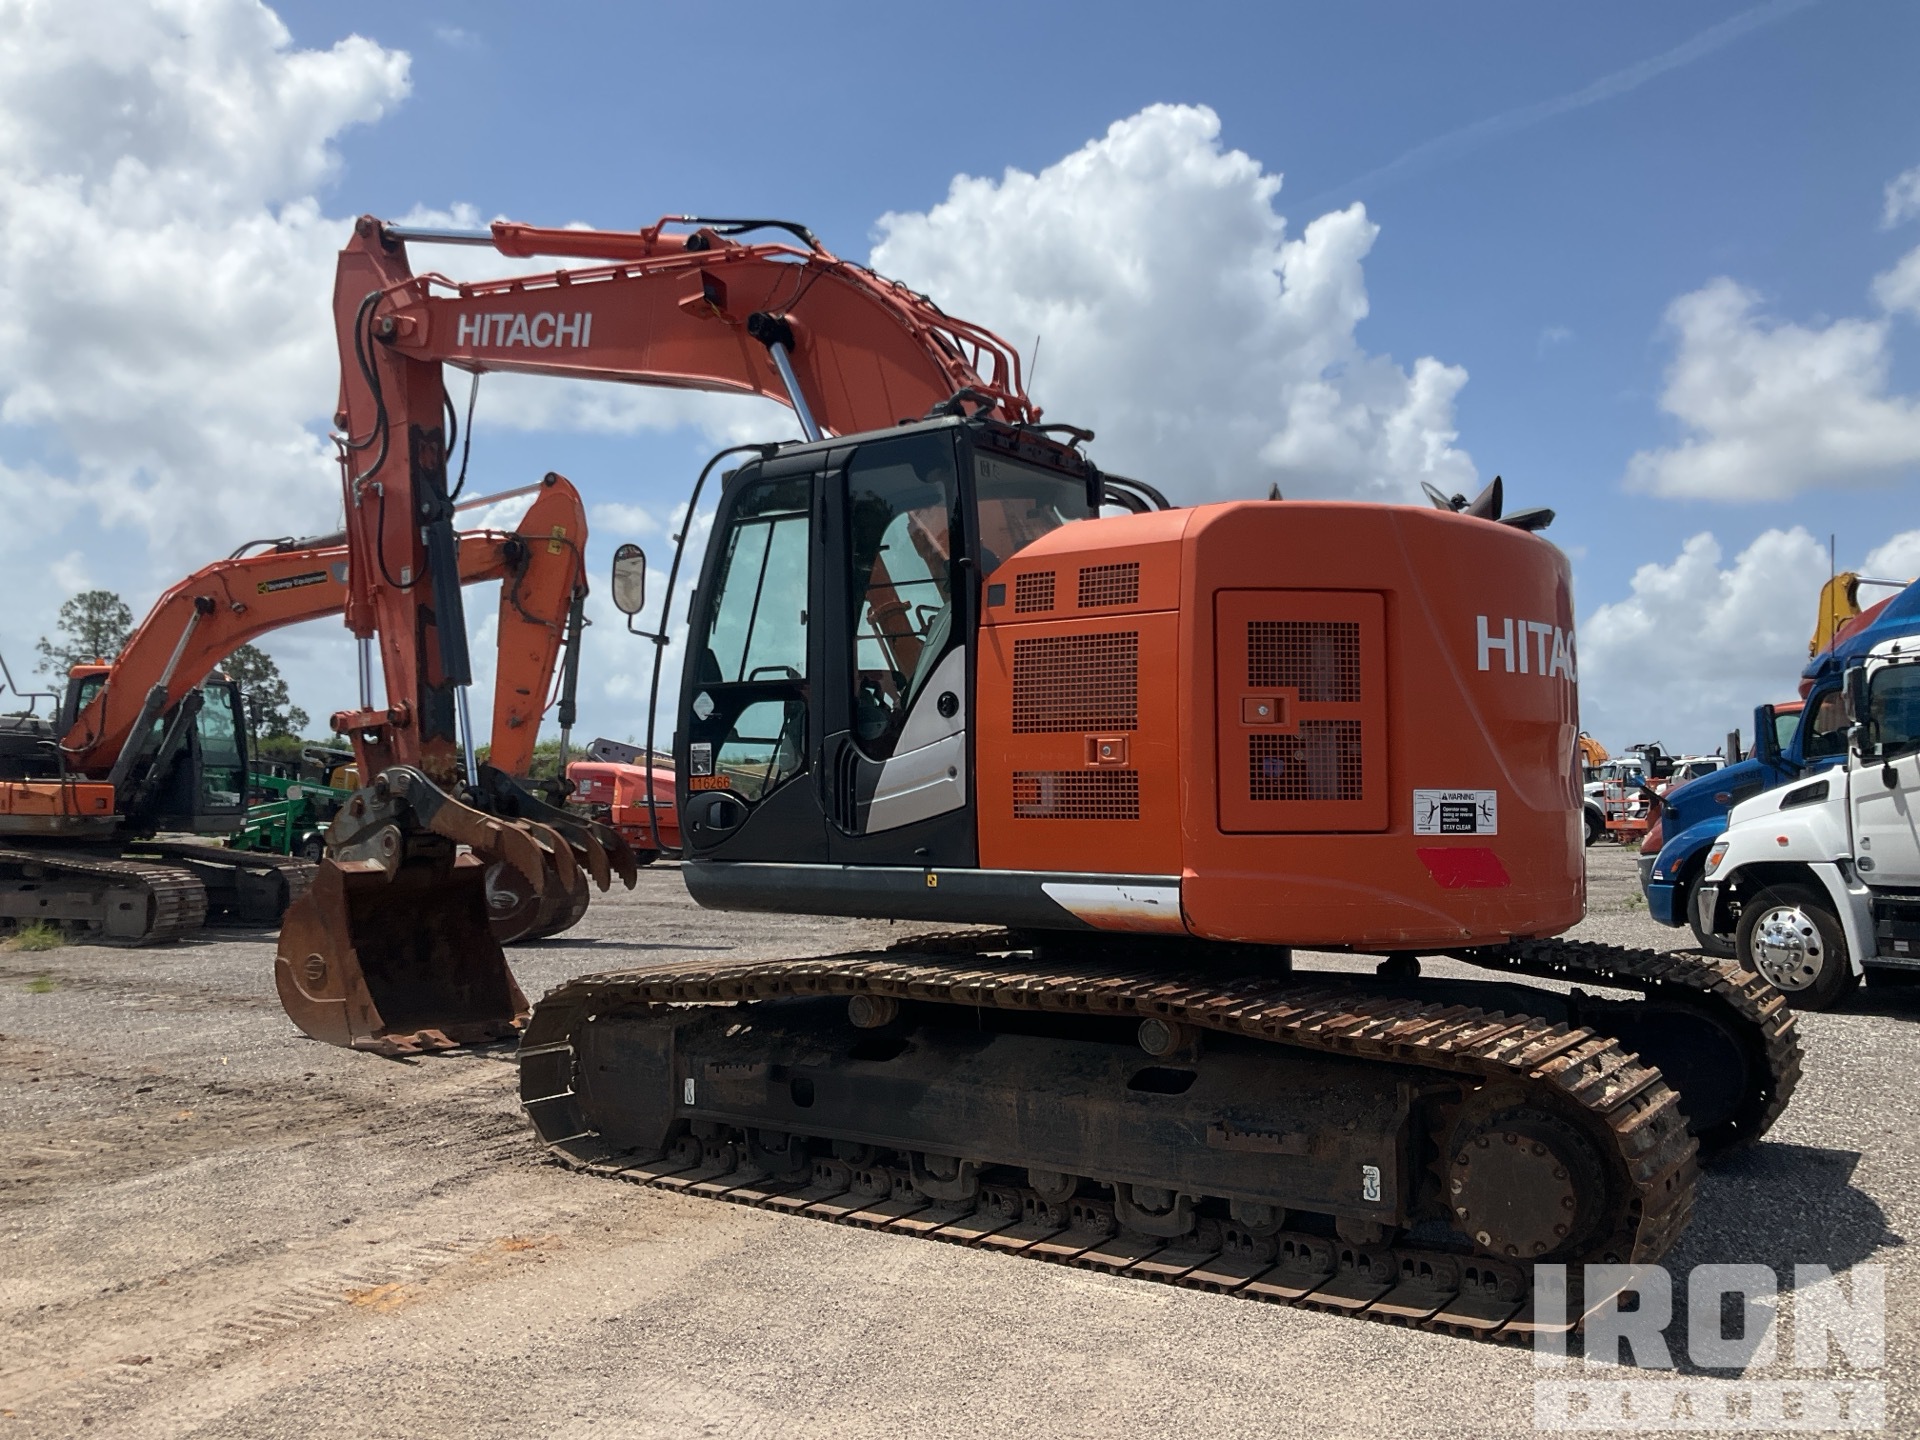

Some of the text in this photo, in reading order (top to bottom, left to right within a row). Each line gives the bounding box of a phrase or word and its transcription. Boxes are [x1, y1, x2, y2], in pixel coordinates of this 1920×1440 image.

[458, 313, 592, 348] HITACHI
[294, 574, 326, 586] Equipment
[691, 776, 730, 790] 116266
